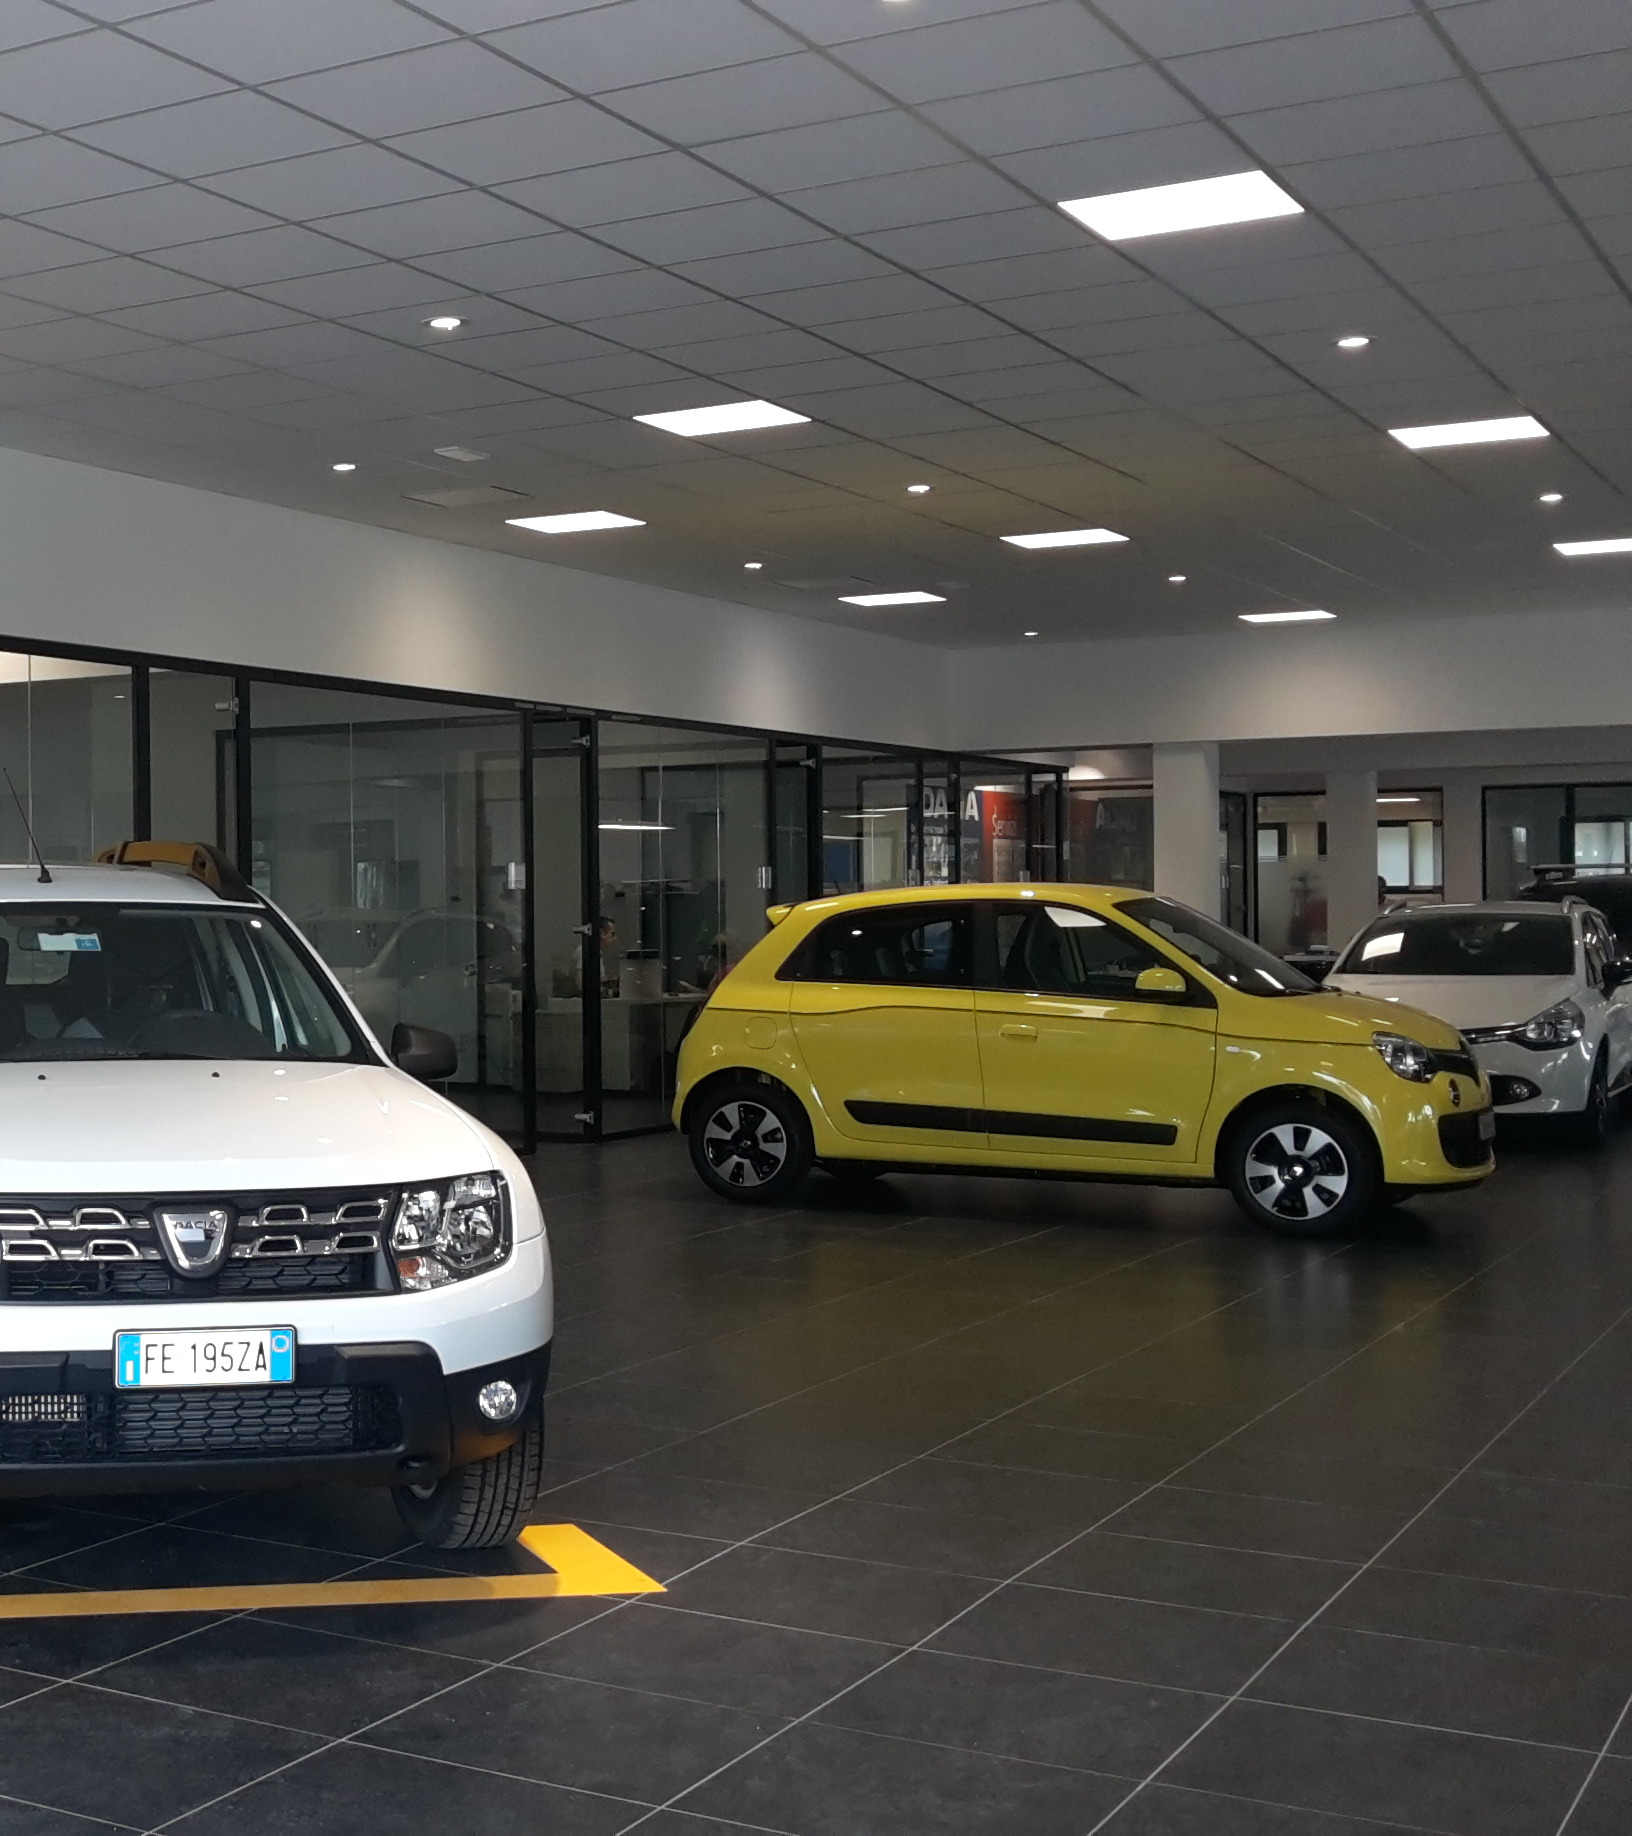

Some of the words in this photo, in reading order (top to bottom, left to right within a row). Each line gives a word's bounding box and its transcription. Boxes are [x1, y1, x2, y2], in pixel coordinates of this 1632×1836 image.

[923, 786, 980, 822] DAIA
[175, 1219, 218, 1229] DACIA
[145, 1343, 175, 1374] FE
[190, 1341, 267, 1373] 195ZA
